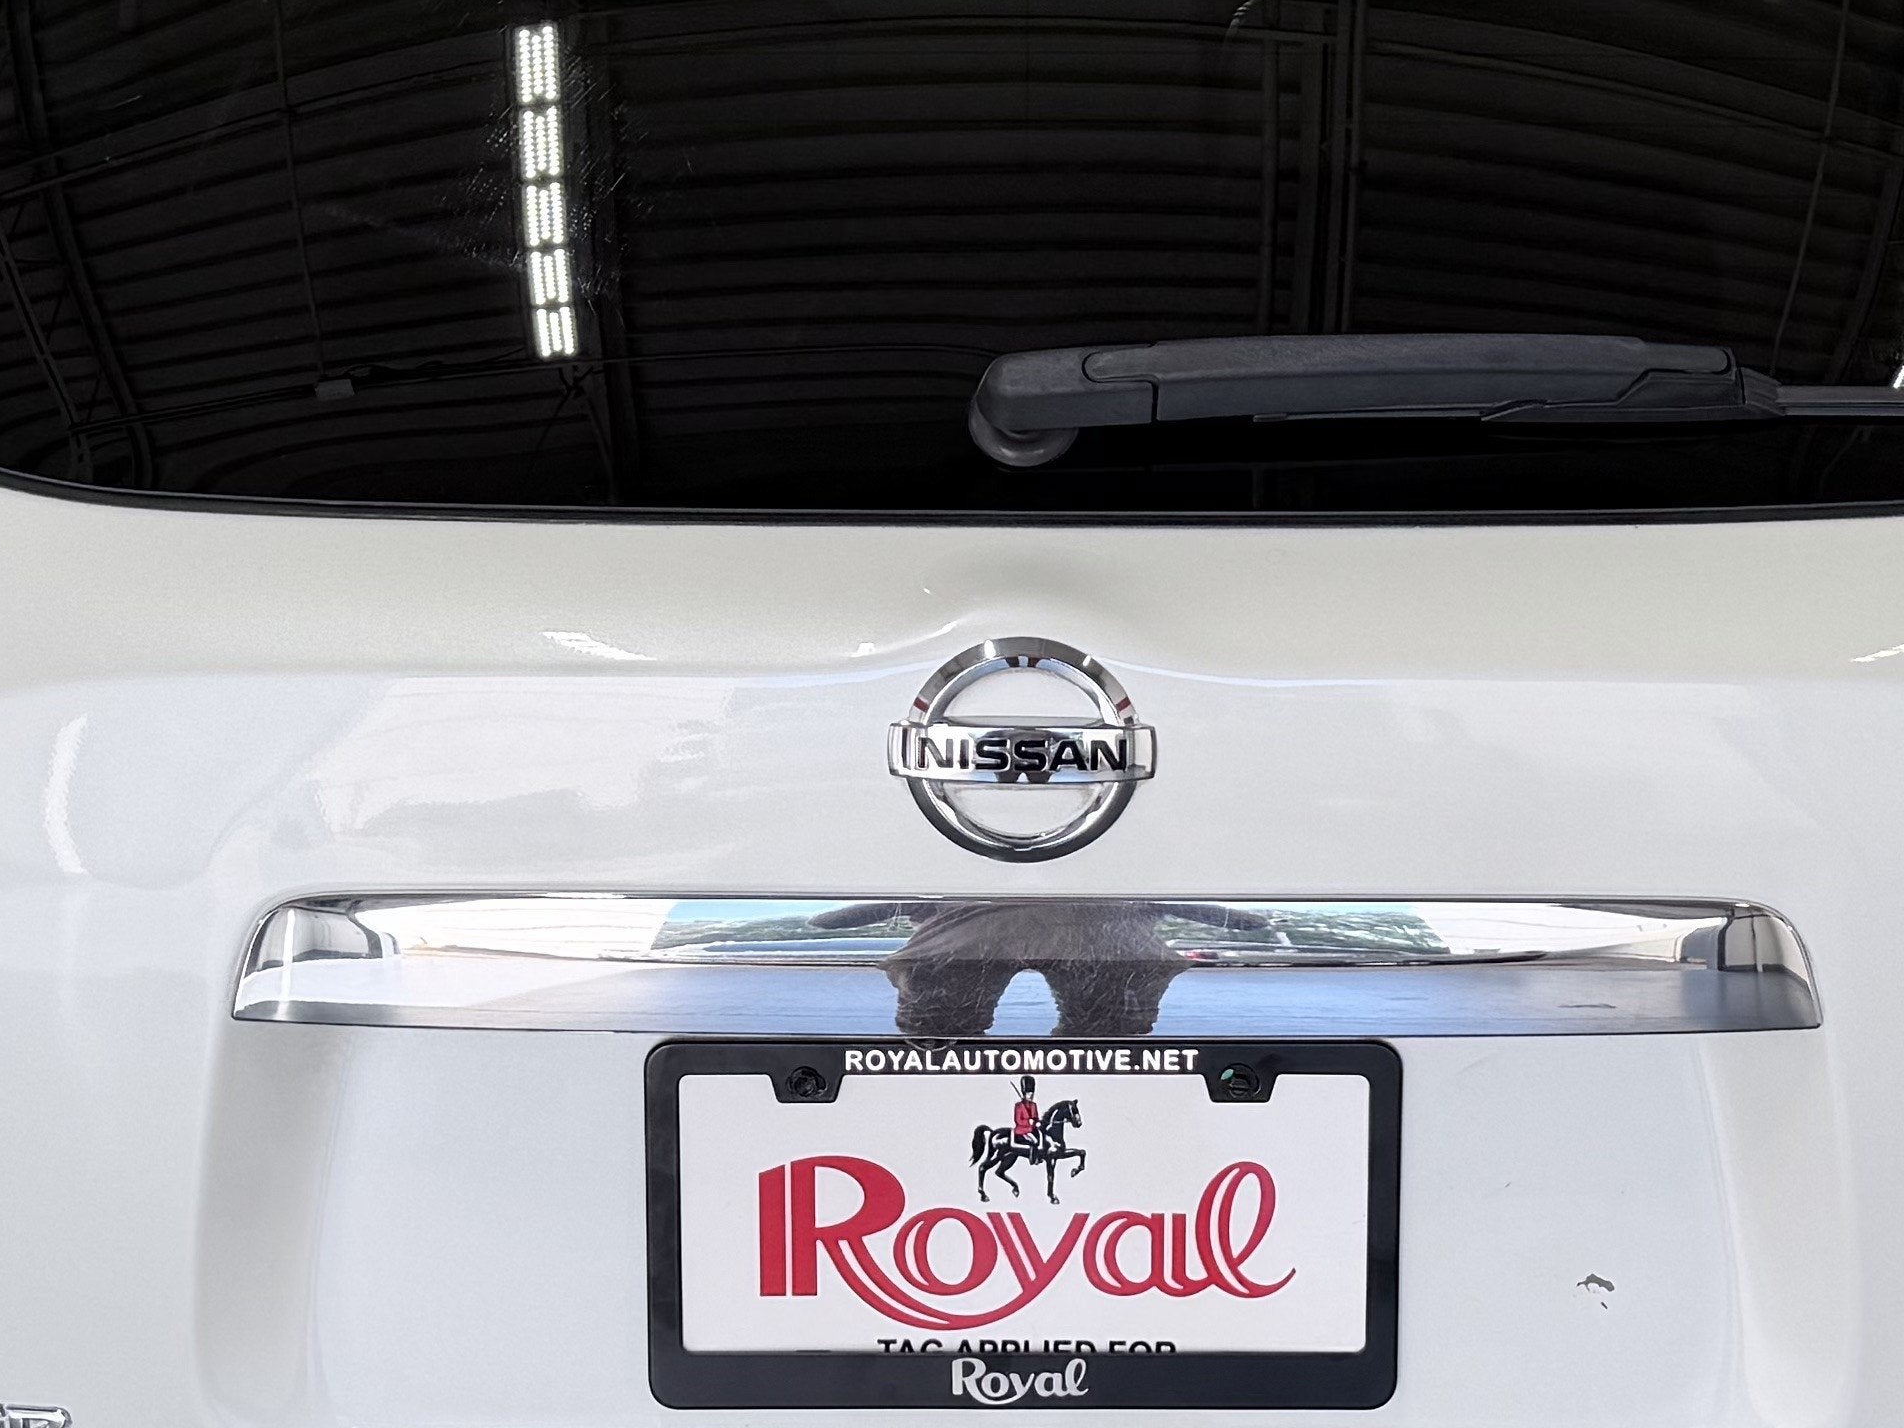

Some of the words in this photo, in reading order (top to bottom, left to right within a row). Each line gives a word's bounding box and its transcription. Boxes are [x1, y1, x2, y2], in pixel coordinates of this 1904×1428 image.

[917, 736, 1128, 773] NISSAN
[844, 1048, 1200, 1072] ROYALAUTOMOTIVE.NET
[758, 1155, 1297, 1331] Royal
[951, 1356, 1090, 1406] Royal
